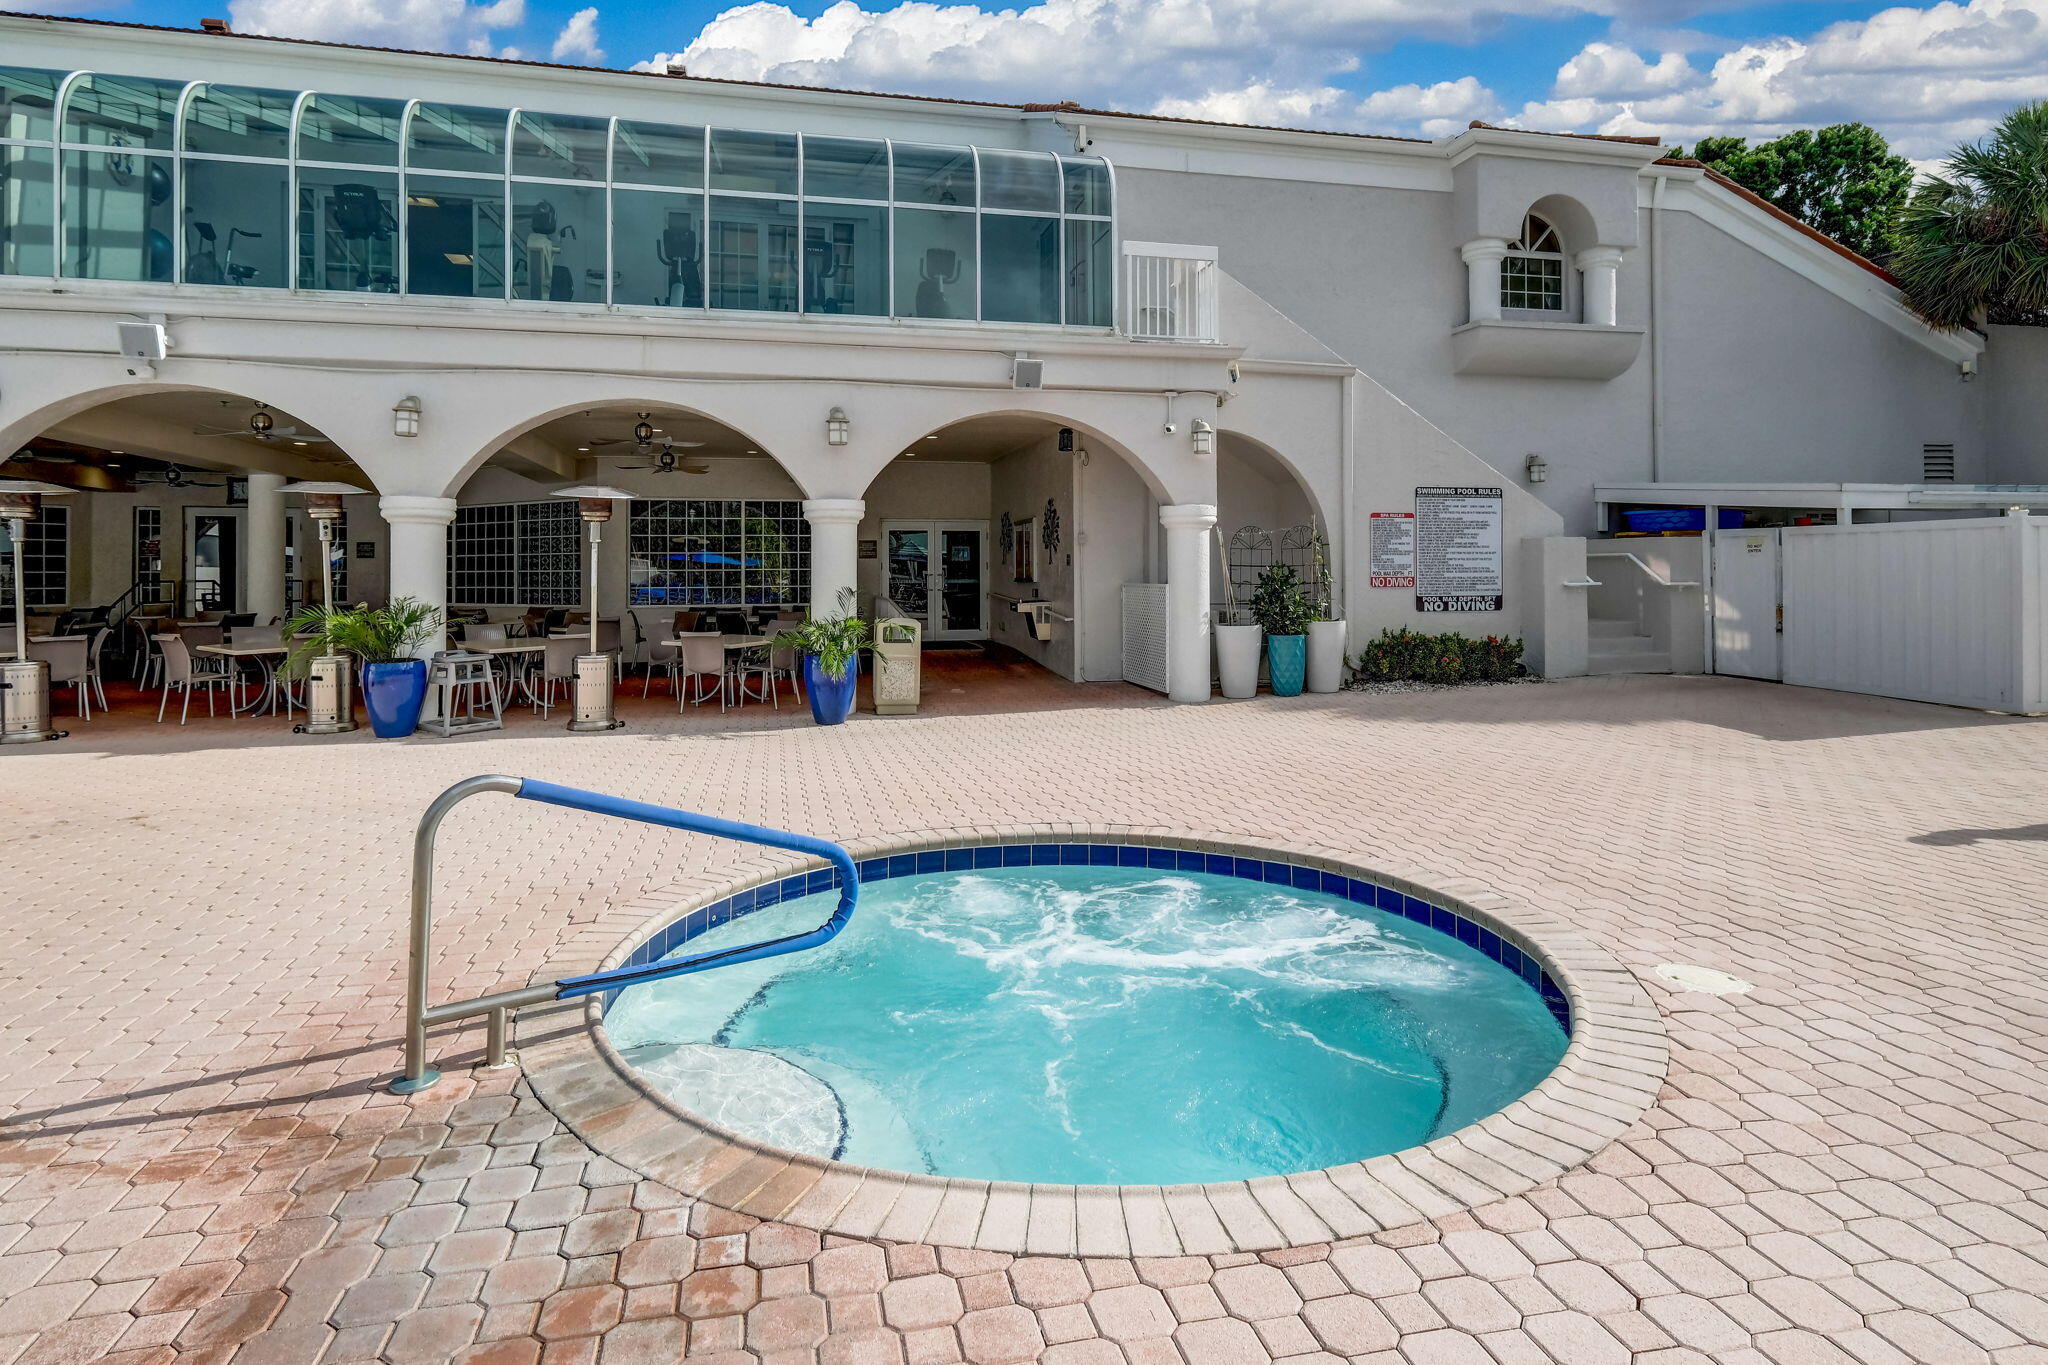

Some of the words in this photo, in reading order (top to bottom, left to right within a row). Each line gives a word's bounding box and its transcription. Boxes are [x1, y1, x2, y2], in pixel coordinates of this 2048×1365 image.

[1372, 577, 1384, 587] NO
[1386, 577, 1413, 587] DIVING
[1423, 601, 1444, 611] NO
[1448, 601, 1495, 611] DIVING
